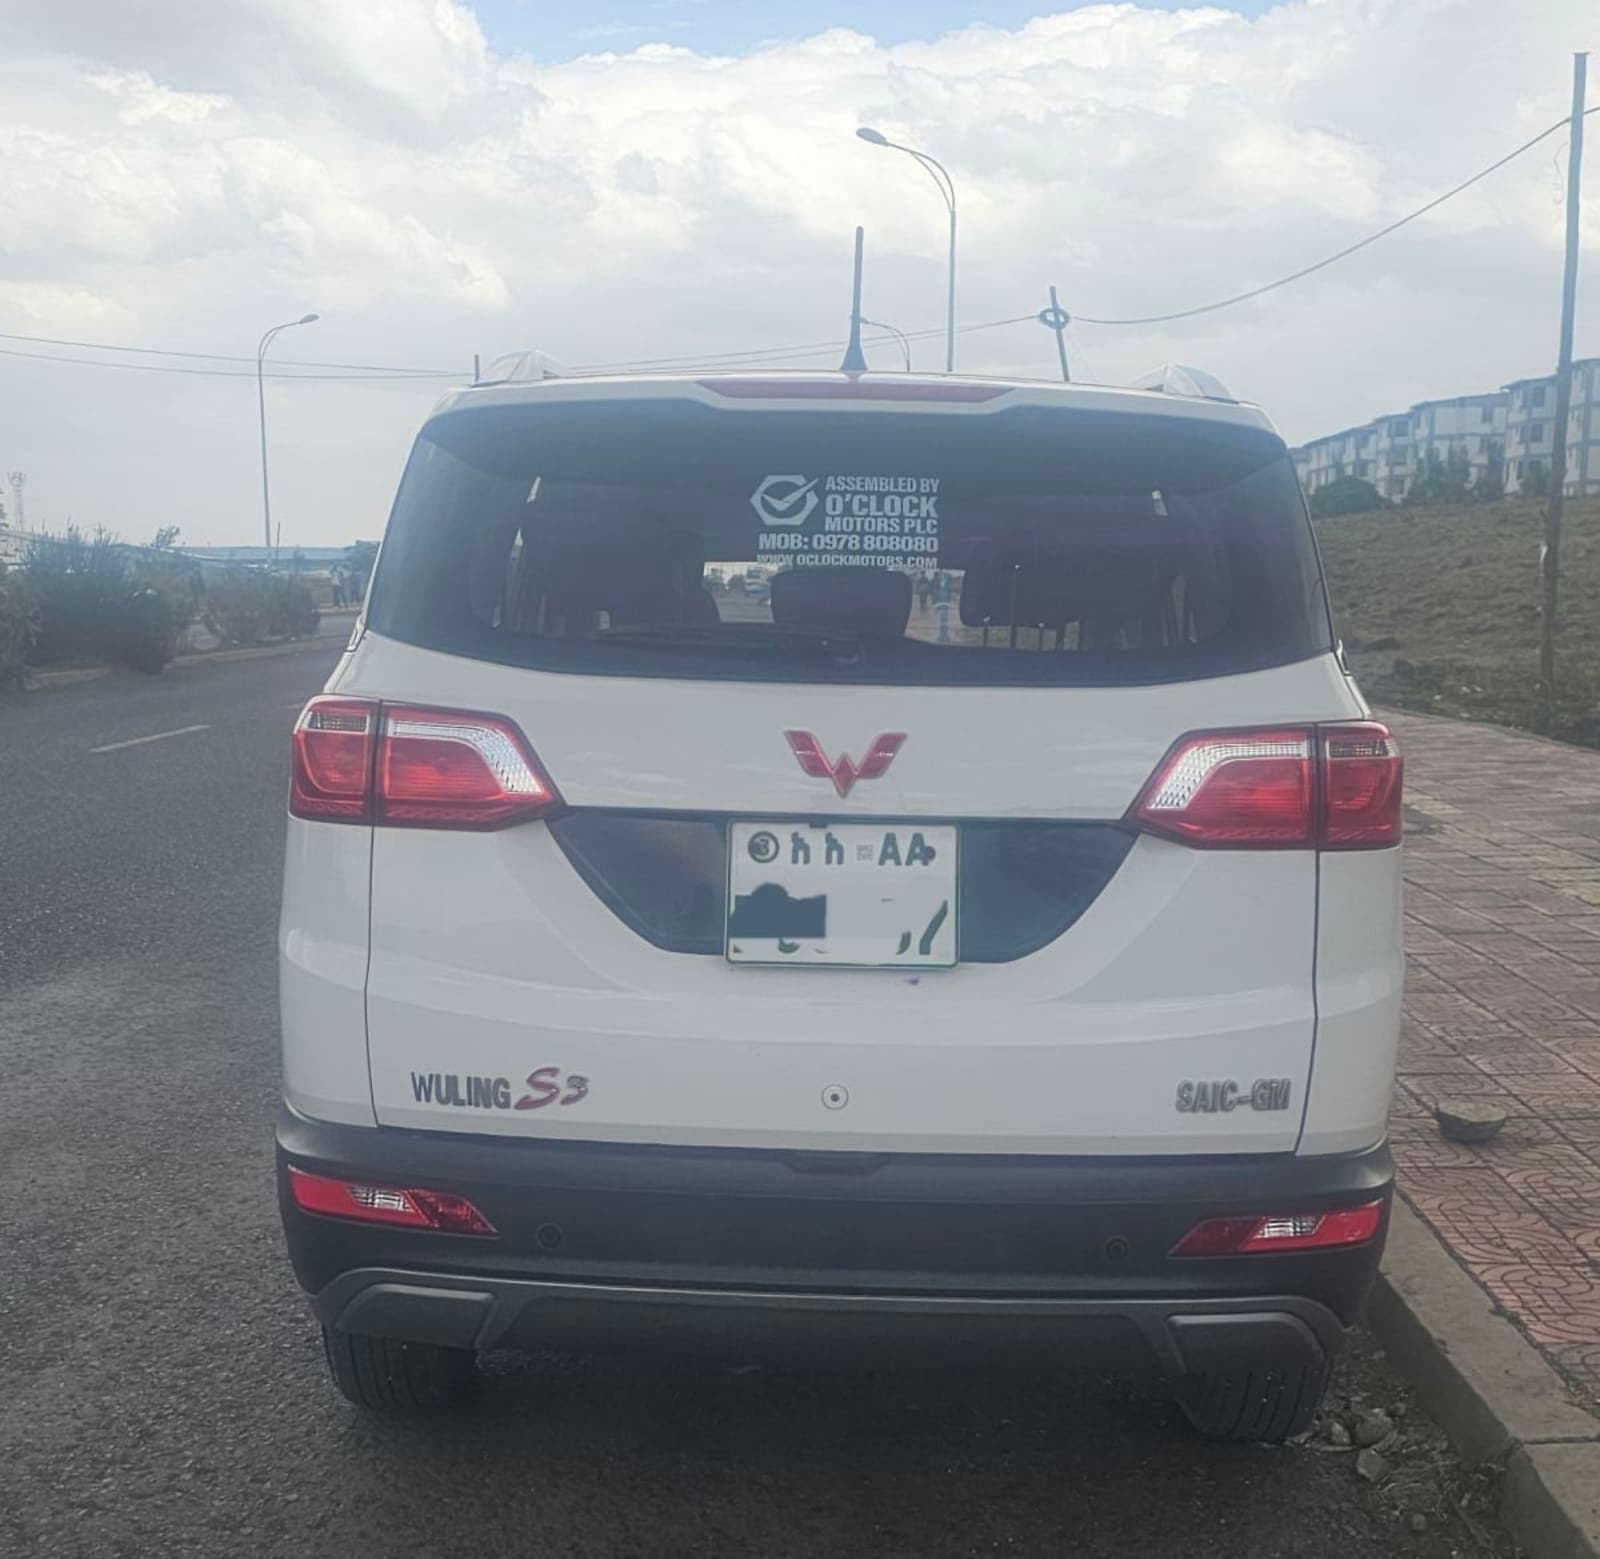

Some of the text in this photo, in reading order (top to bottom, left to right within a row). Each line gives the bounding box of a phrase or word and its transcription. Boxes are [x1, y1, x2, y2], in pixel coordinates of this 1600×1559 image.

[825, 476, 940, 493] ASSEMBLED BY
[825, 494, 938, 518] O'CLOCK
[825, 517, 938, 534] MOTORS PLC
[759, 533, 939, 553] MOB: 0978 808080
[757, 554, 937, 569] WWWOCLOCKMOTORS.COM
[878, 832, 930, 866] AA
[410, 1067, 589, 1110] WULING S3
[1175, 1079, 1291, 1113] SAIC-GM
